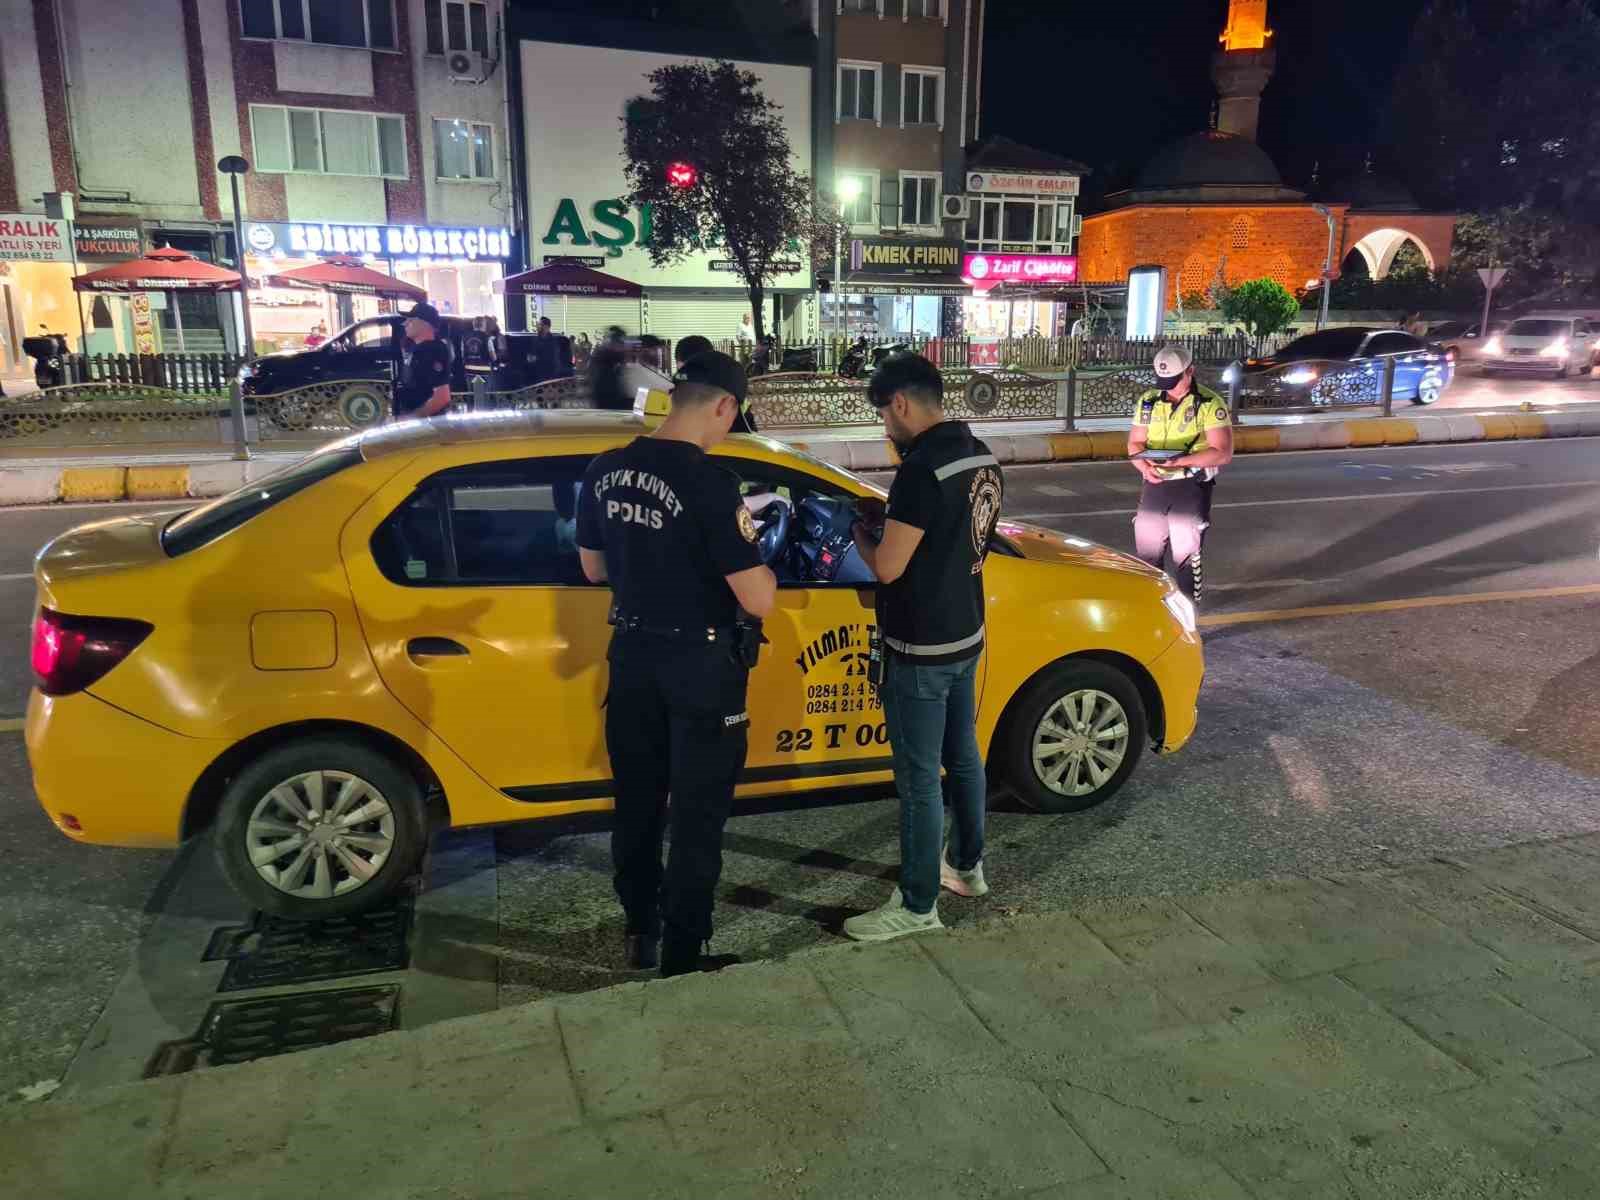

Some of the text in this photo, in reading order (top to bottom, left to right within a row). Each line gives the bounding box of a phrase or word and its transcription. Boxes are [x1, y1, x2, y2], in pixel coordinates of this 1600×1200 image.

[288, 222, 511, 259] EDİRNE BÖREKÇİSİ
[913, 246, 959, 265] FIRINI
[992, 260, 1021, 273] Zarif
[807, 684, 838, 699] 0284
[806, 700, 837, 714] 0284
[776, 728, 813, 753] 22
[825, 723, 847, 748] T
